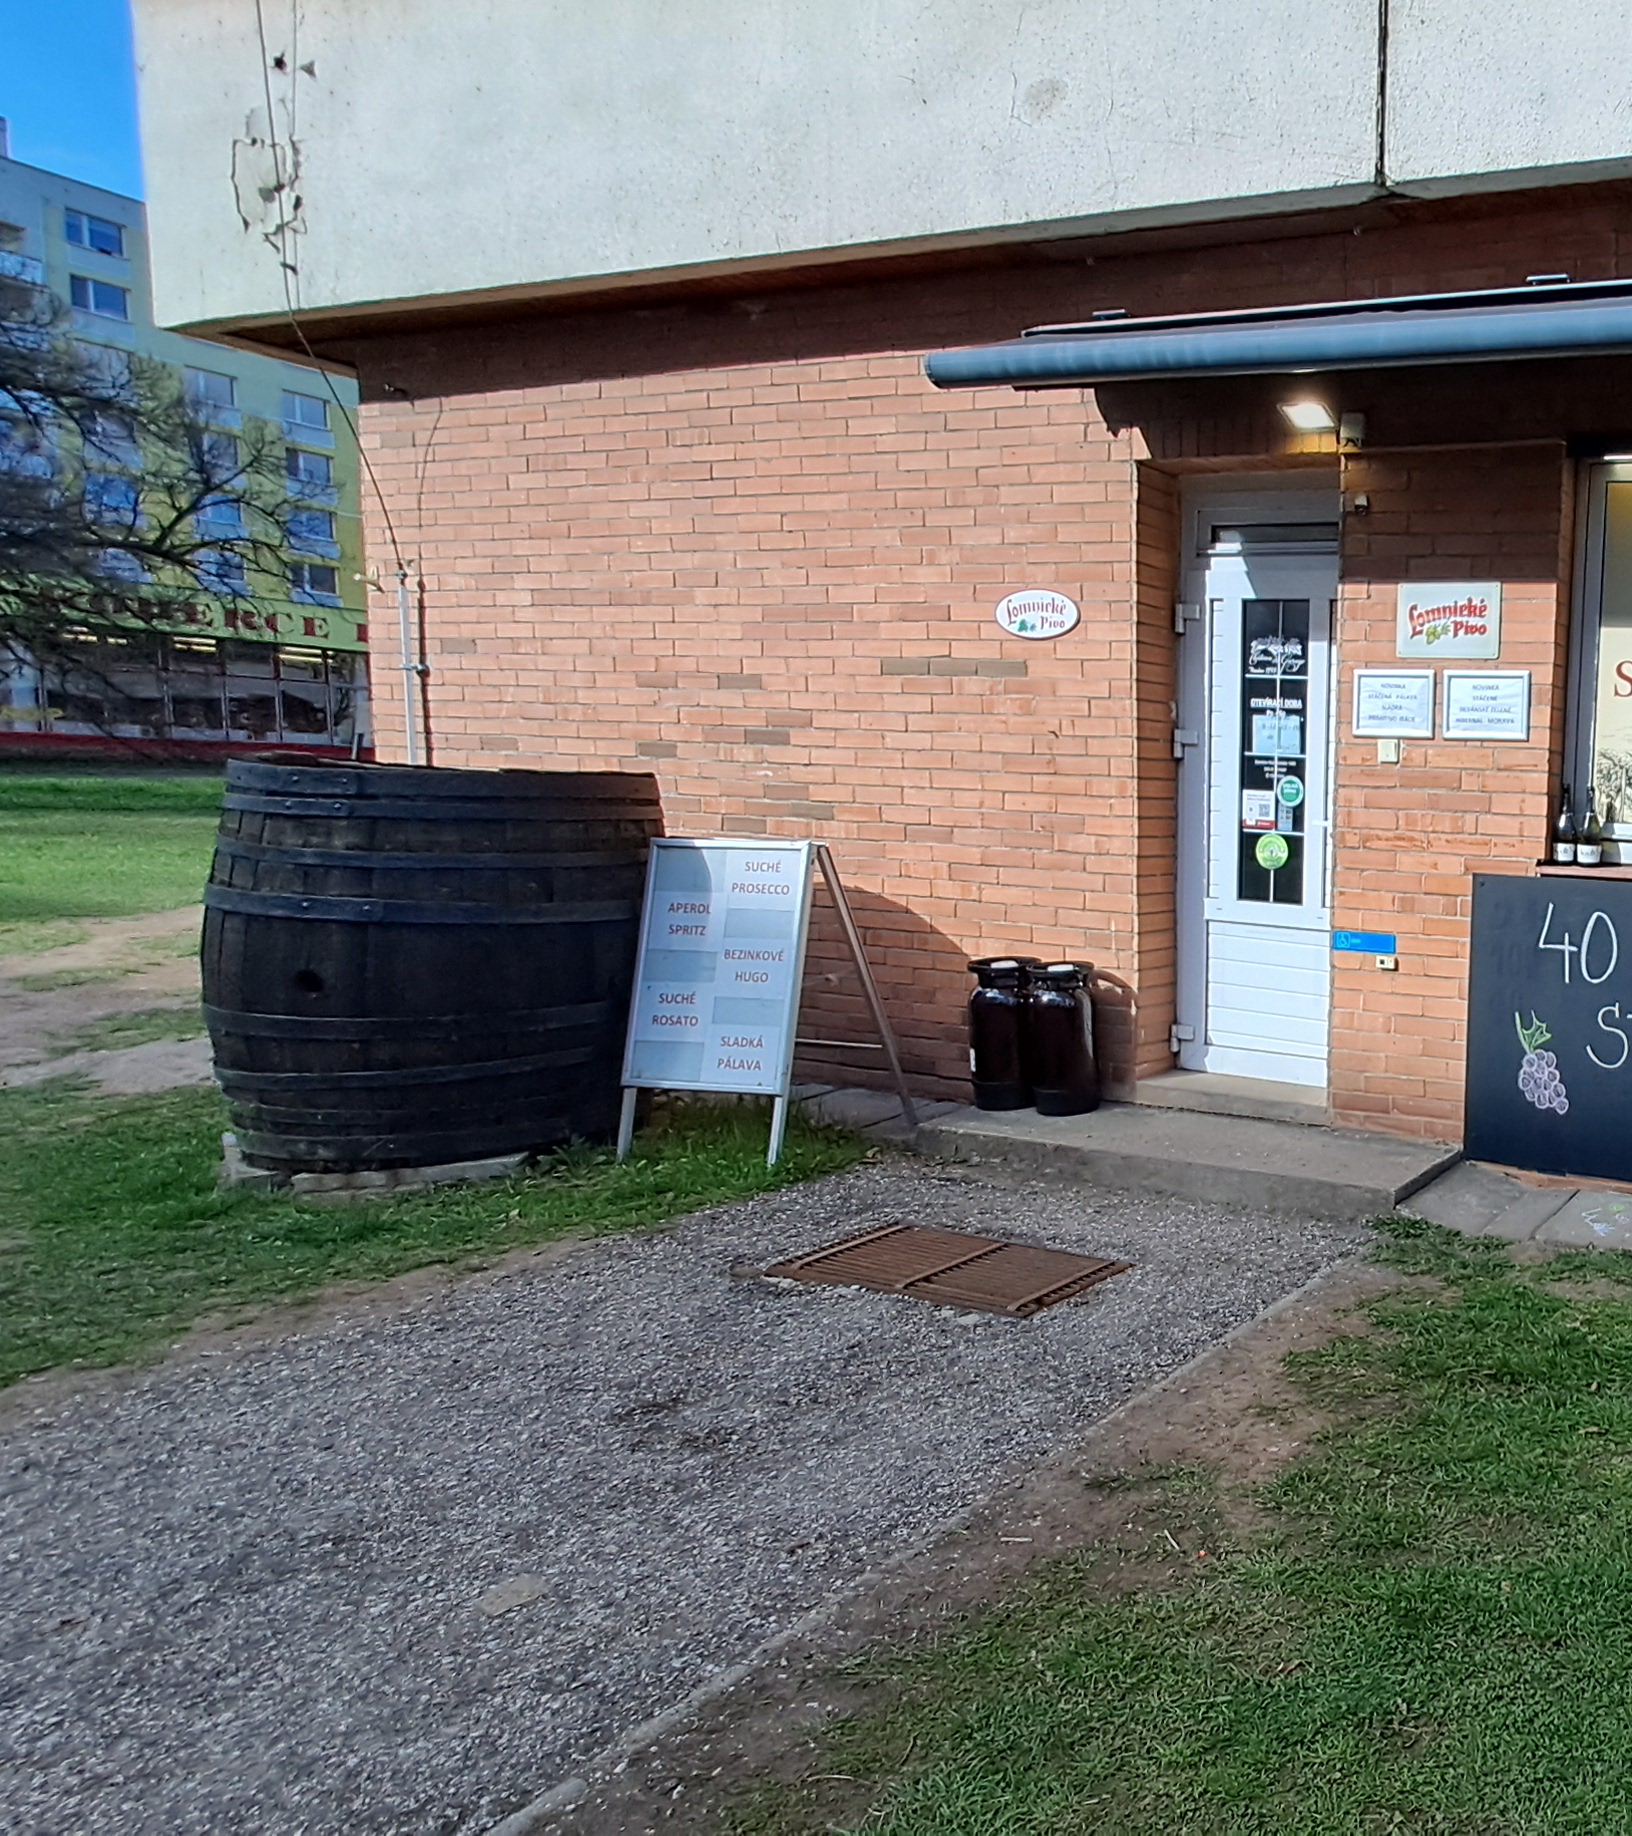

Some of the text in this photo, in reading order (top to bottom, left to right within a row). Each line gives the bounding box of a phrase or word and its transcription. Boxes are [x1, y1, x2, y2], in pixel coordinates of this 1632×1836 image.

[1040, 616, 1066, 630] Pivo
[1451, 620, 1487, 639] Pivo
[745, 860, 781, 873] SUCHÉ
[732, 882, 790, 895] PROSECCO
[668, 902, 711, 914] APEROL
[668, 924, 707, 936] SPRITZ
[1537, 902, 1618, 985] 40
[723, 948, 784, 962] BEZINKOVÉ
[735, 971, 769, 983] HUGO
[658, 991, 697, 1004] SUCHÉ
[652, 1014, 699, 1027] ROSATO
[720, 1035, 764, 1049] SLADKÁ
[717, 1058, 762, 1071] PÁLAVA
